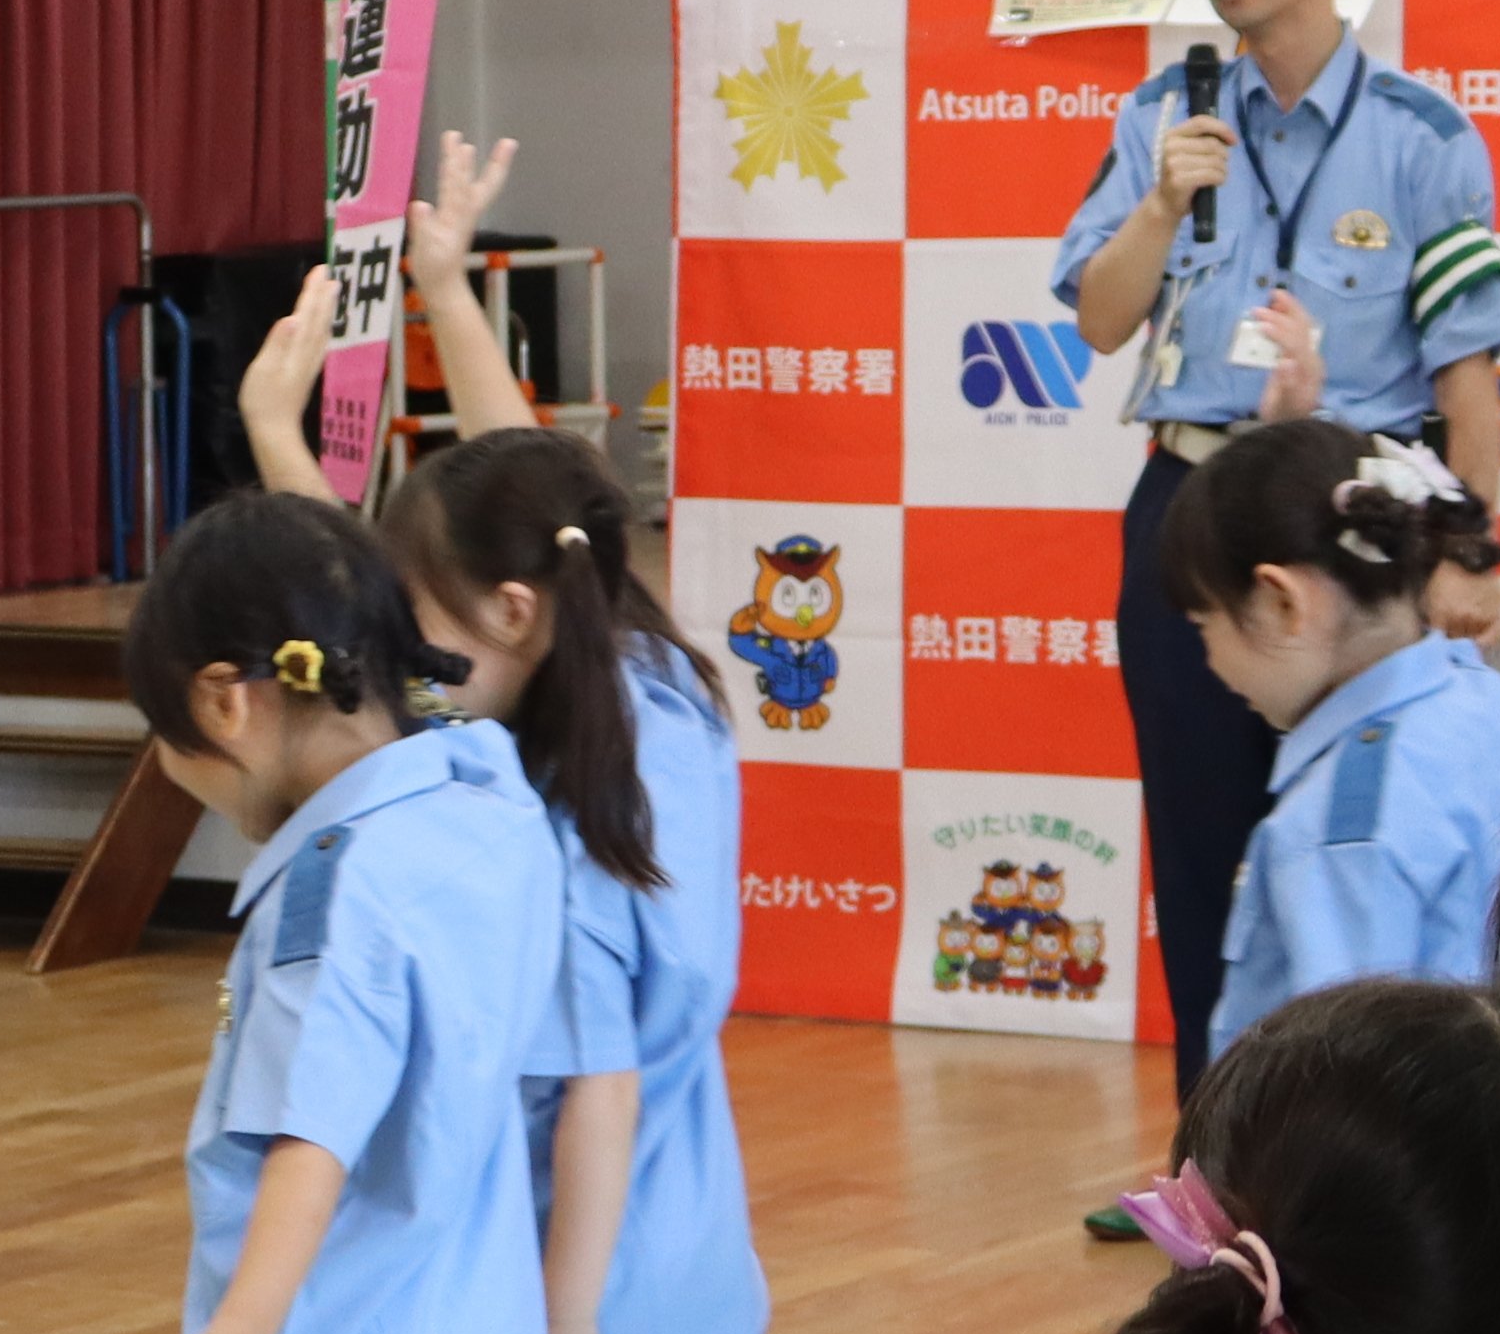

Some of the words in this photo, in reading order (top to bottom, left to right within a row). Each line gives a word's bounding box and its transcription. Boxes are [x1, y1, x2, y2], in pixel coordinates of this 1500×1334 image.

[918, 87, 1030, 123] Atsuta
[681, 344, 896, 397] 熱田警察署
